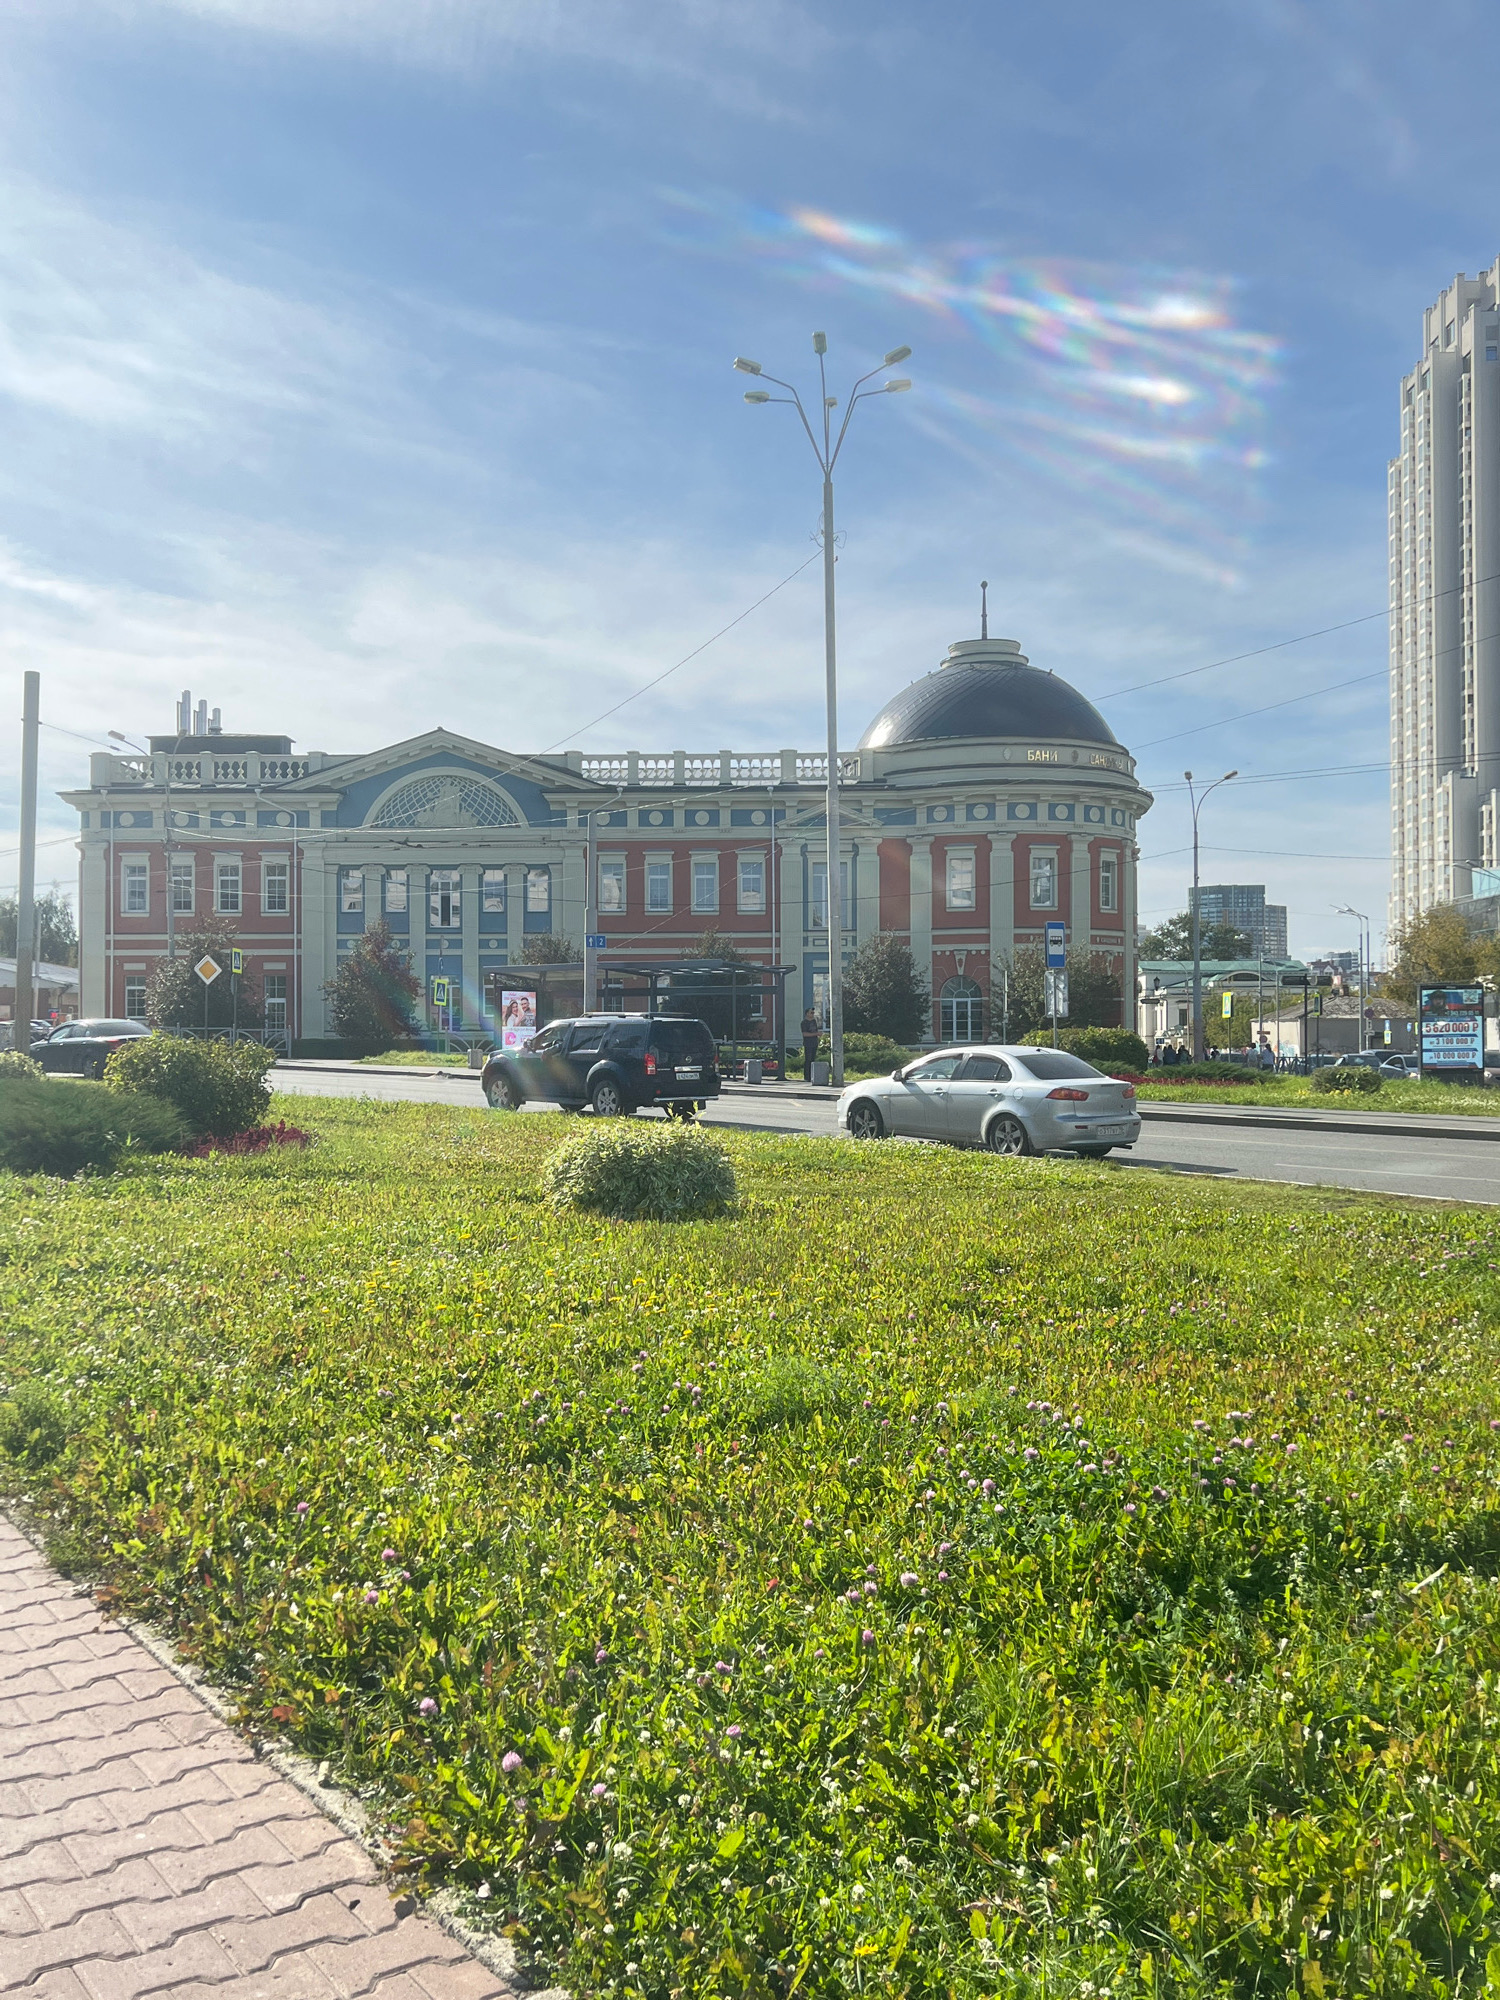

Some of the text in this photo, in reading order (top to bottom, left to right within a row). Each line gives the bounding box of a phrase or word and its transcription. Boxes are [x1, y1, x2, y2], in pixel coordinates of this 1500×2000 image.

[1027, 750, 1058, 762] БАНИ
[599, 937, 604, 946] 2
[1425, 1022, 1432, 1033] 5
[1432, 1022, 1450, 1033] 620
[1451, 1022, 1470, 1033] 000
[1435, 1037, 1440, 1045] 3
[1441, 1037, 1454, 1045] 100
[1455, 1037, 1469, 1045] 000
